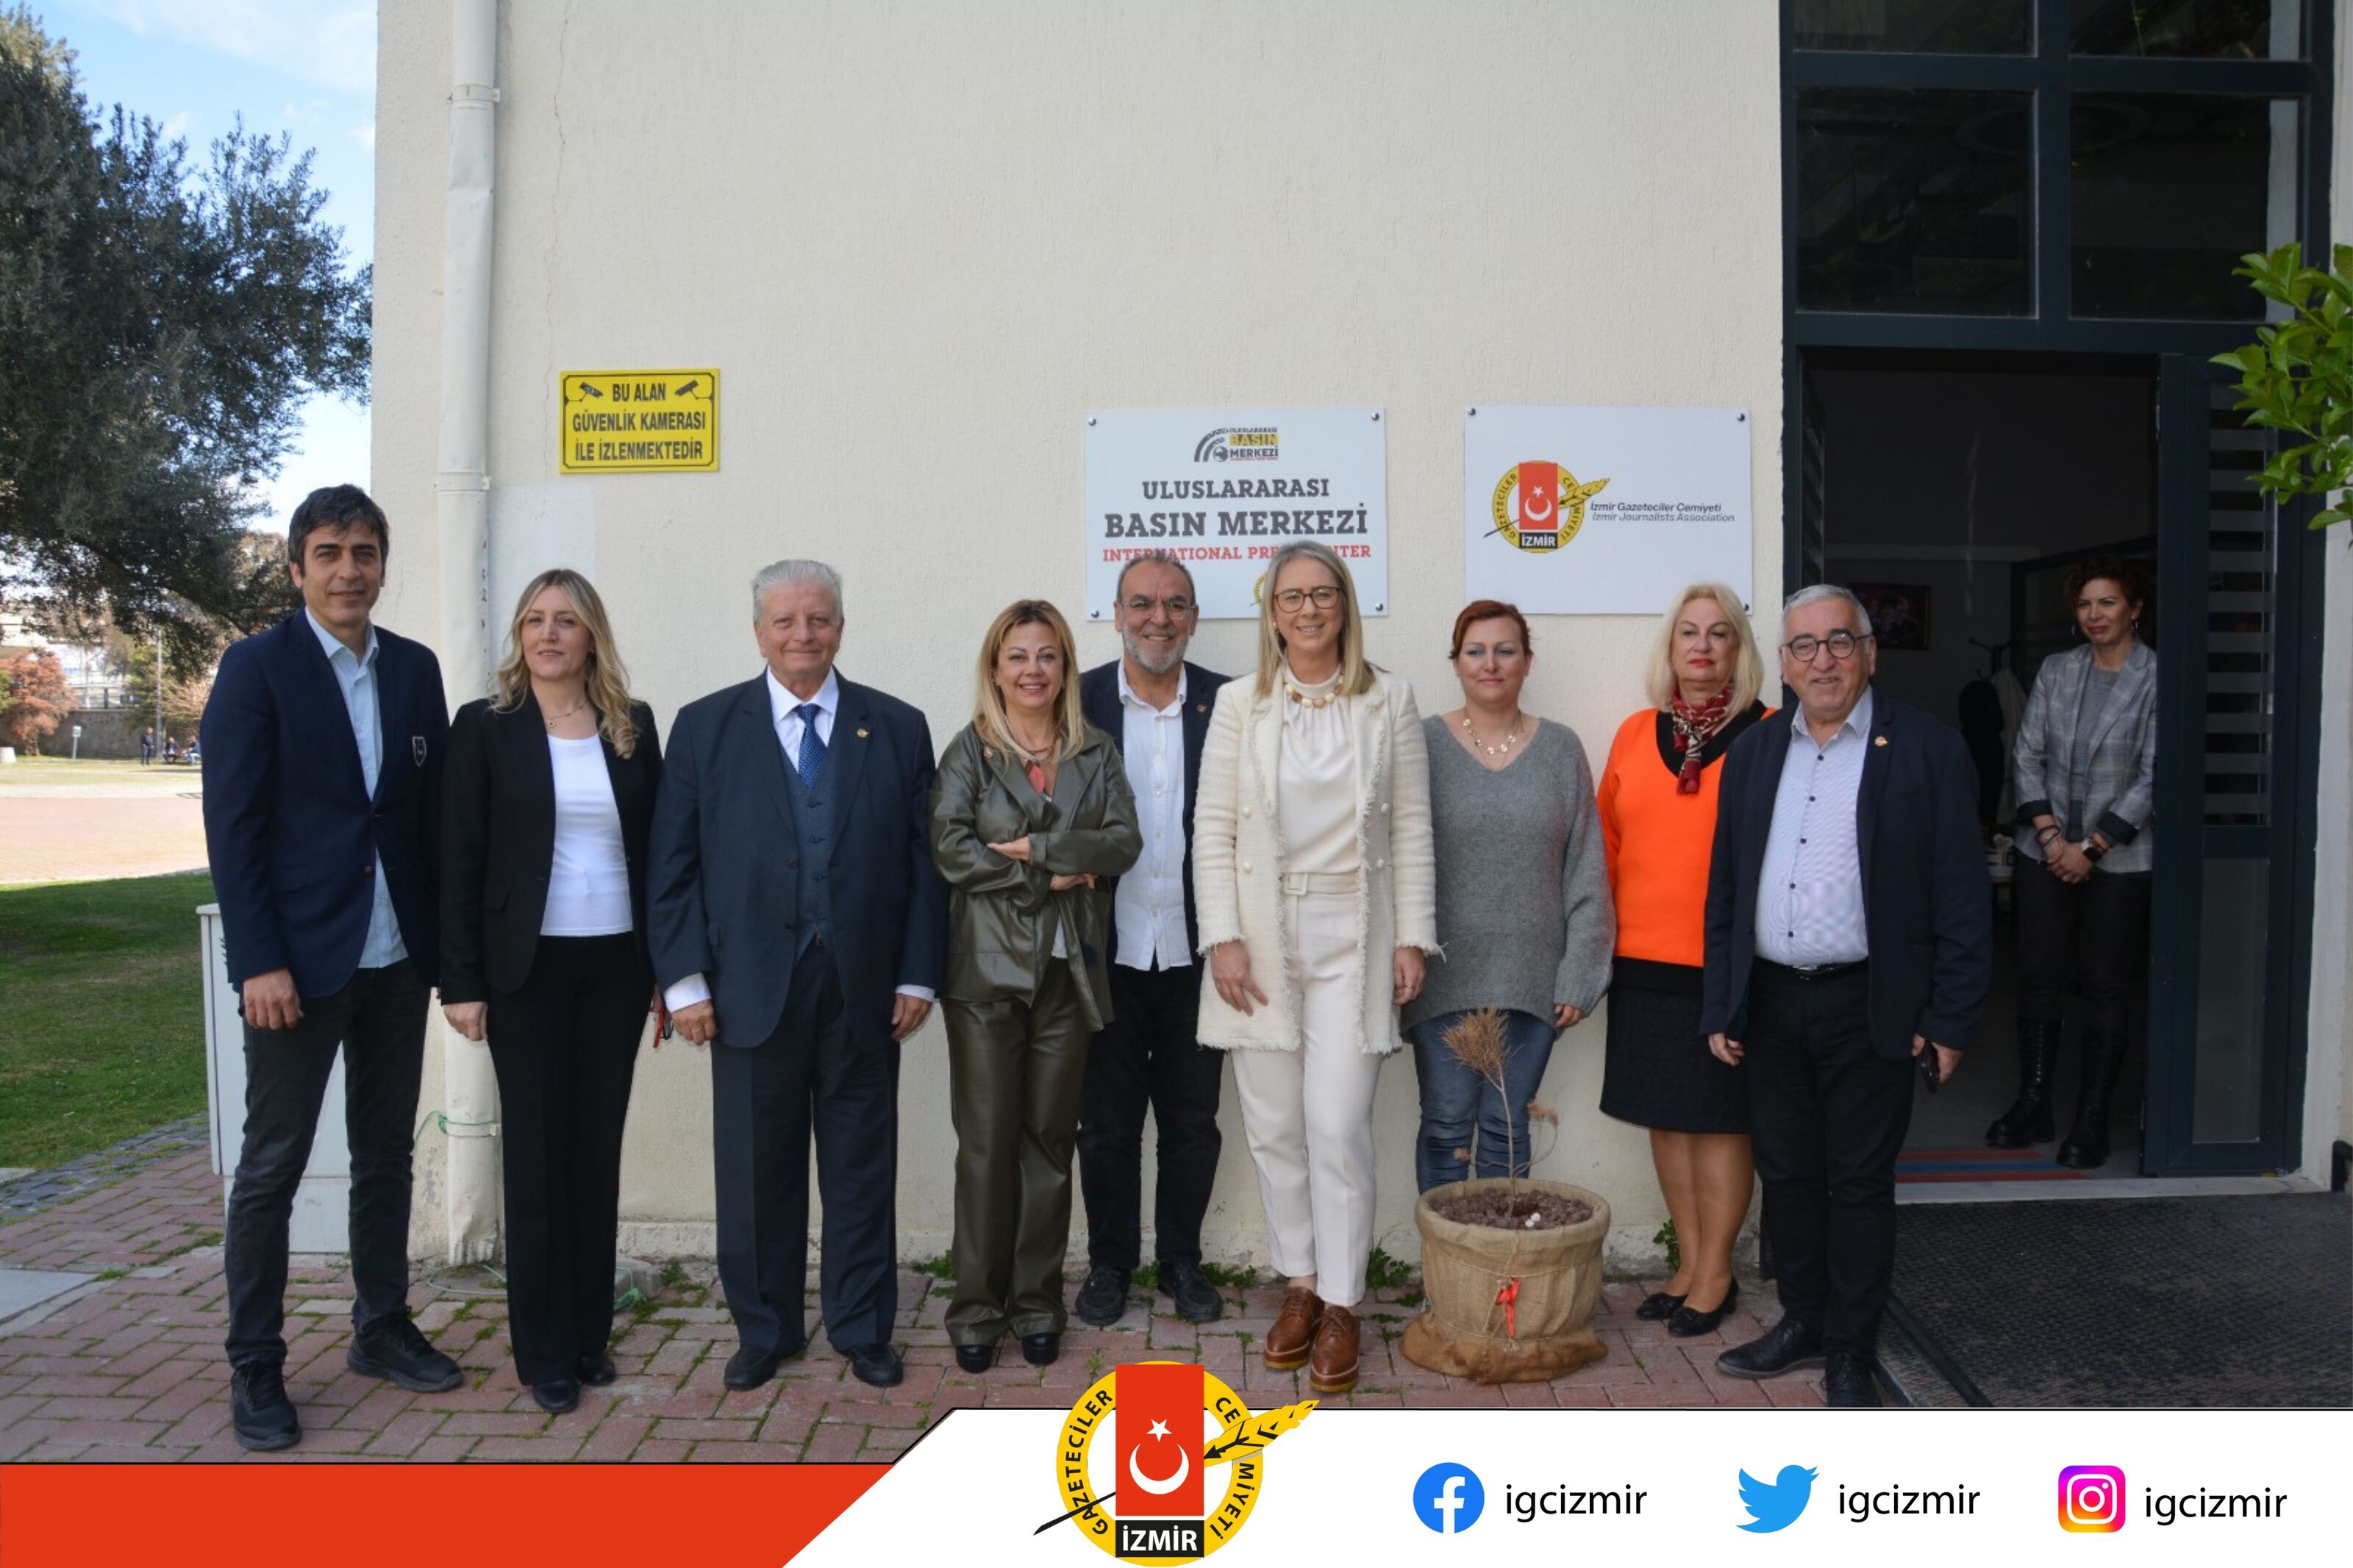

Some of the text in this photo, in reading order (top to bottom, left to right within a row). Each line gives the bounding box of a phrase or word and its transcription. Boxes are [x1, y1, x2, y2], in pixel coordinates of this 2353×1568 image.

[613, 382, 666, 402] BU ALAN
[573, 409, 706, 432] GÜVENLİK KAMERASI
[1230, 434, 1279, 445] BASIN
[576, 437, 703, 461] İLE İZLENMEKTEDİR
[1229, 445, 1279, 458] MERKEZİ
[1142, 478, 1330, 501] ULUSLARARASI
[1618, 502, 1674, 512] Gazeteciler
[1676, 501, 1721, 513] Cemiyeti
[1104, 502, 1368, 539] BASIN MERKEZİ
[1619, 512, 1674, 522] Journalists
[1676, 512, 1735, 522] Association
[1521, 533, 1556, 547] İZMİR
